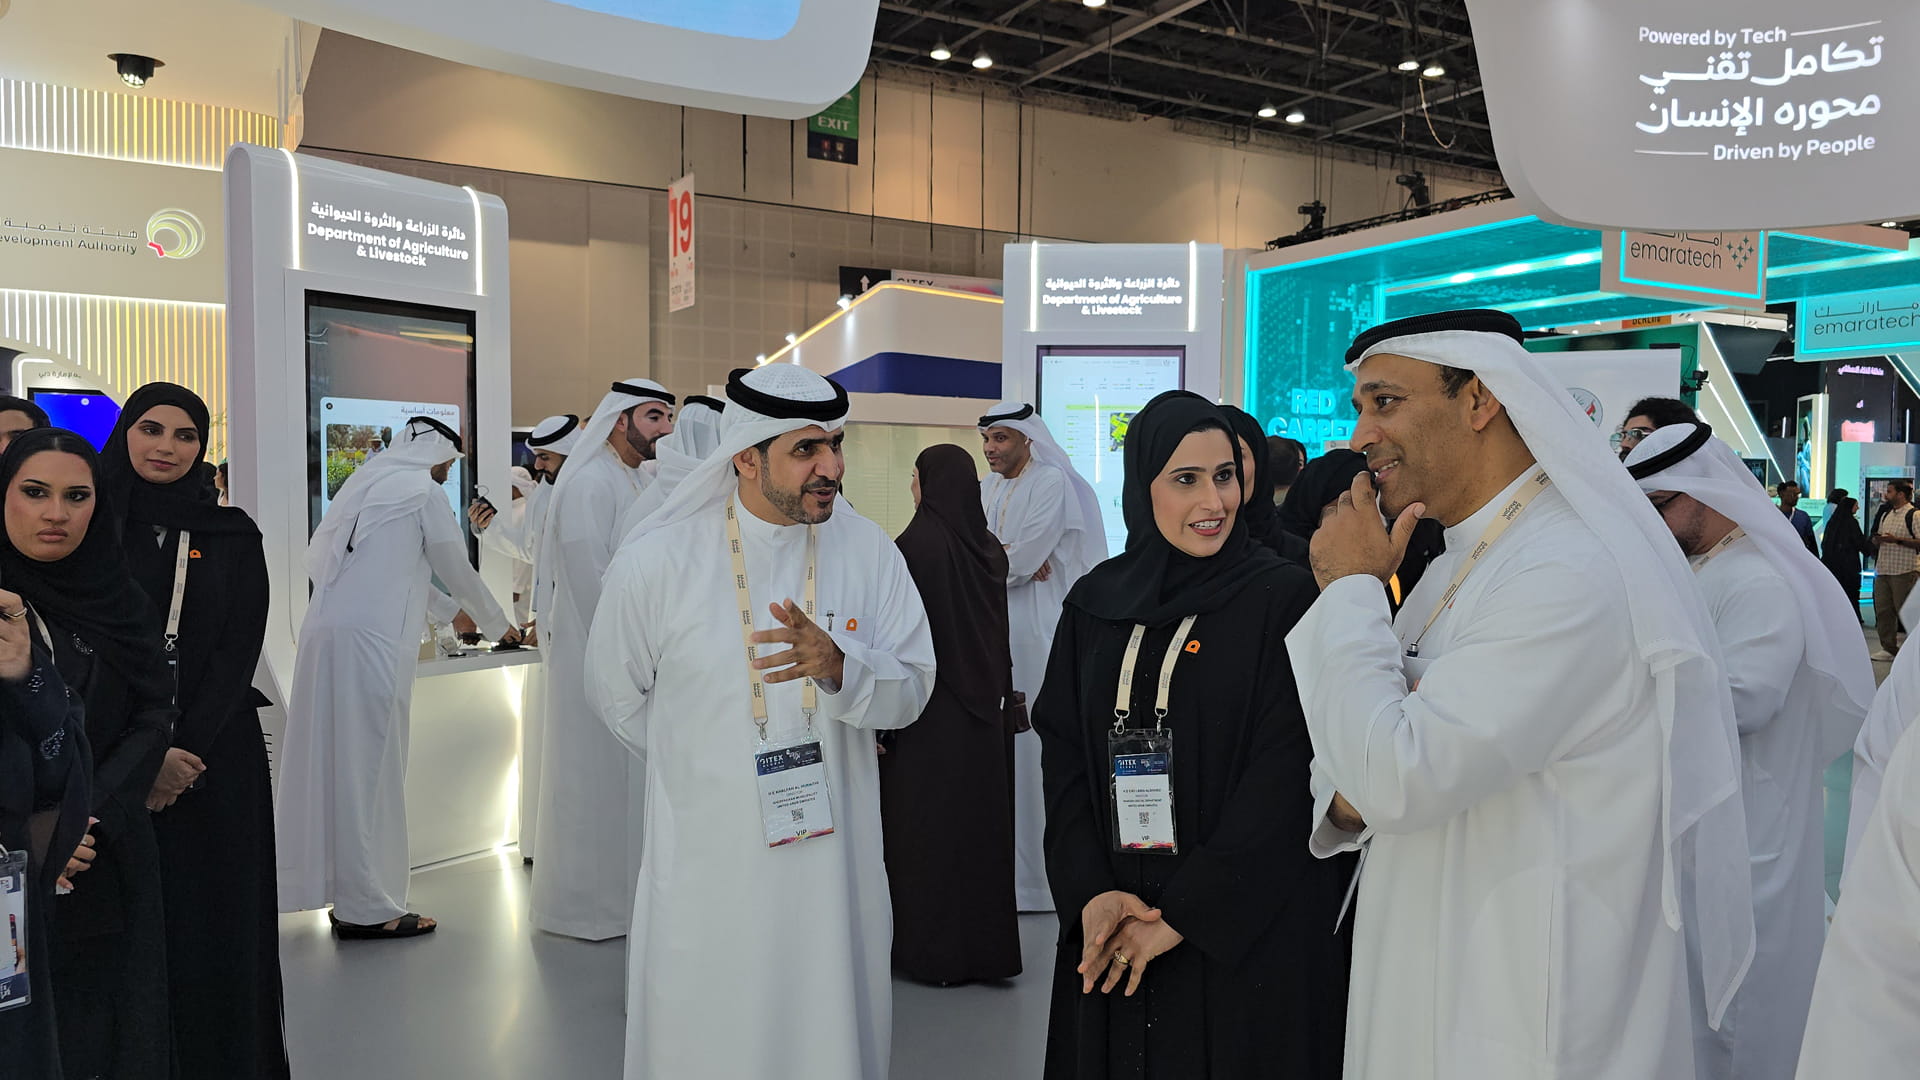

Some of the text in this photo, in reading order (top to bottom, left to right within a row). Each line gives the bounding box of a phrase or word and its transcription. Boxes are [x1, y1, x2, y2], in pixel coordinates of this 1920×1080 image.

[1639, 27, 1786, 48] Powered by Tech
[1750, 36, 1884, 86] تكامل
[818, 116, 849, 131] EXIT
[1636, 94, 1880, 136] محوره الإنسان
[1714, 135, 1875, 160] Driven by People
[311, 201, 465, 240] دائرة الزراعة والثروة الحيوانية
[669, 190, 692, 257] 19
[0, 232, 138, 255] velopment Authority
[308, 223, 469, 260] Department of Agriculture
[356, 245, 427, 266] & Livestock
[1630, 241, 1722, 269] emaratech
[1042, 294, 1182, 307] Department of Agriculture
[1081, 305, 1142, 315] & Livestock
[1814, 311, 1920, 335] emaratech
[1291, 388, 1336, 415] RED
